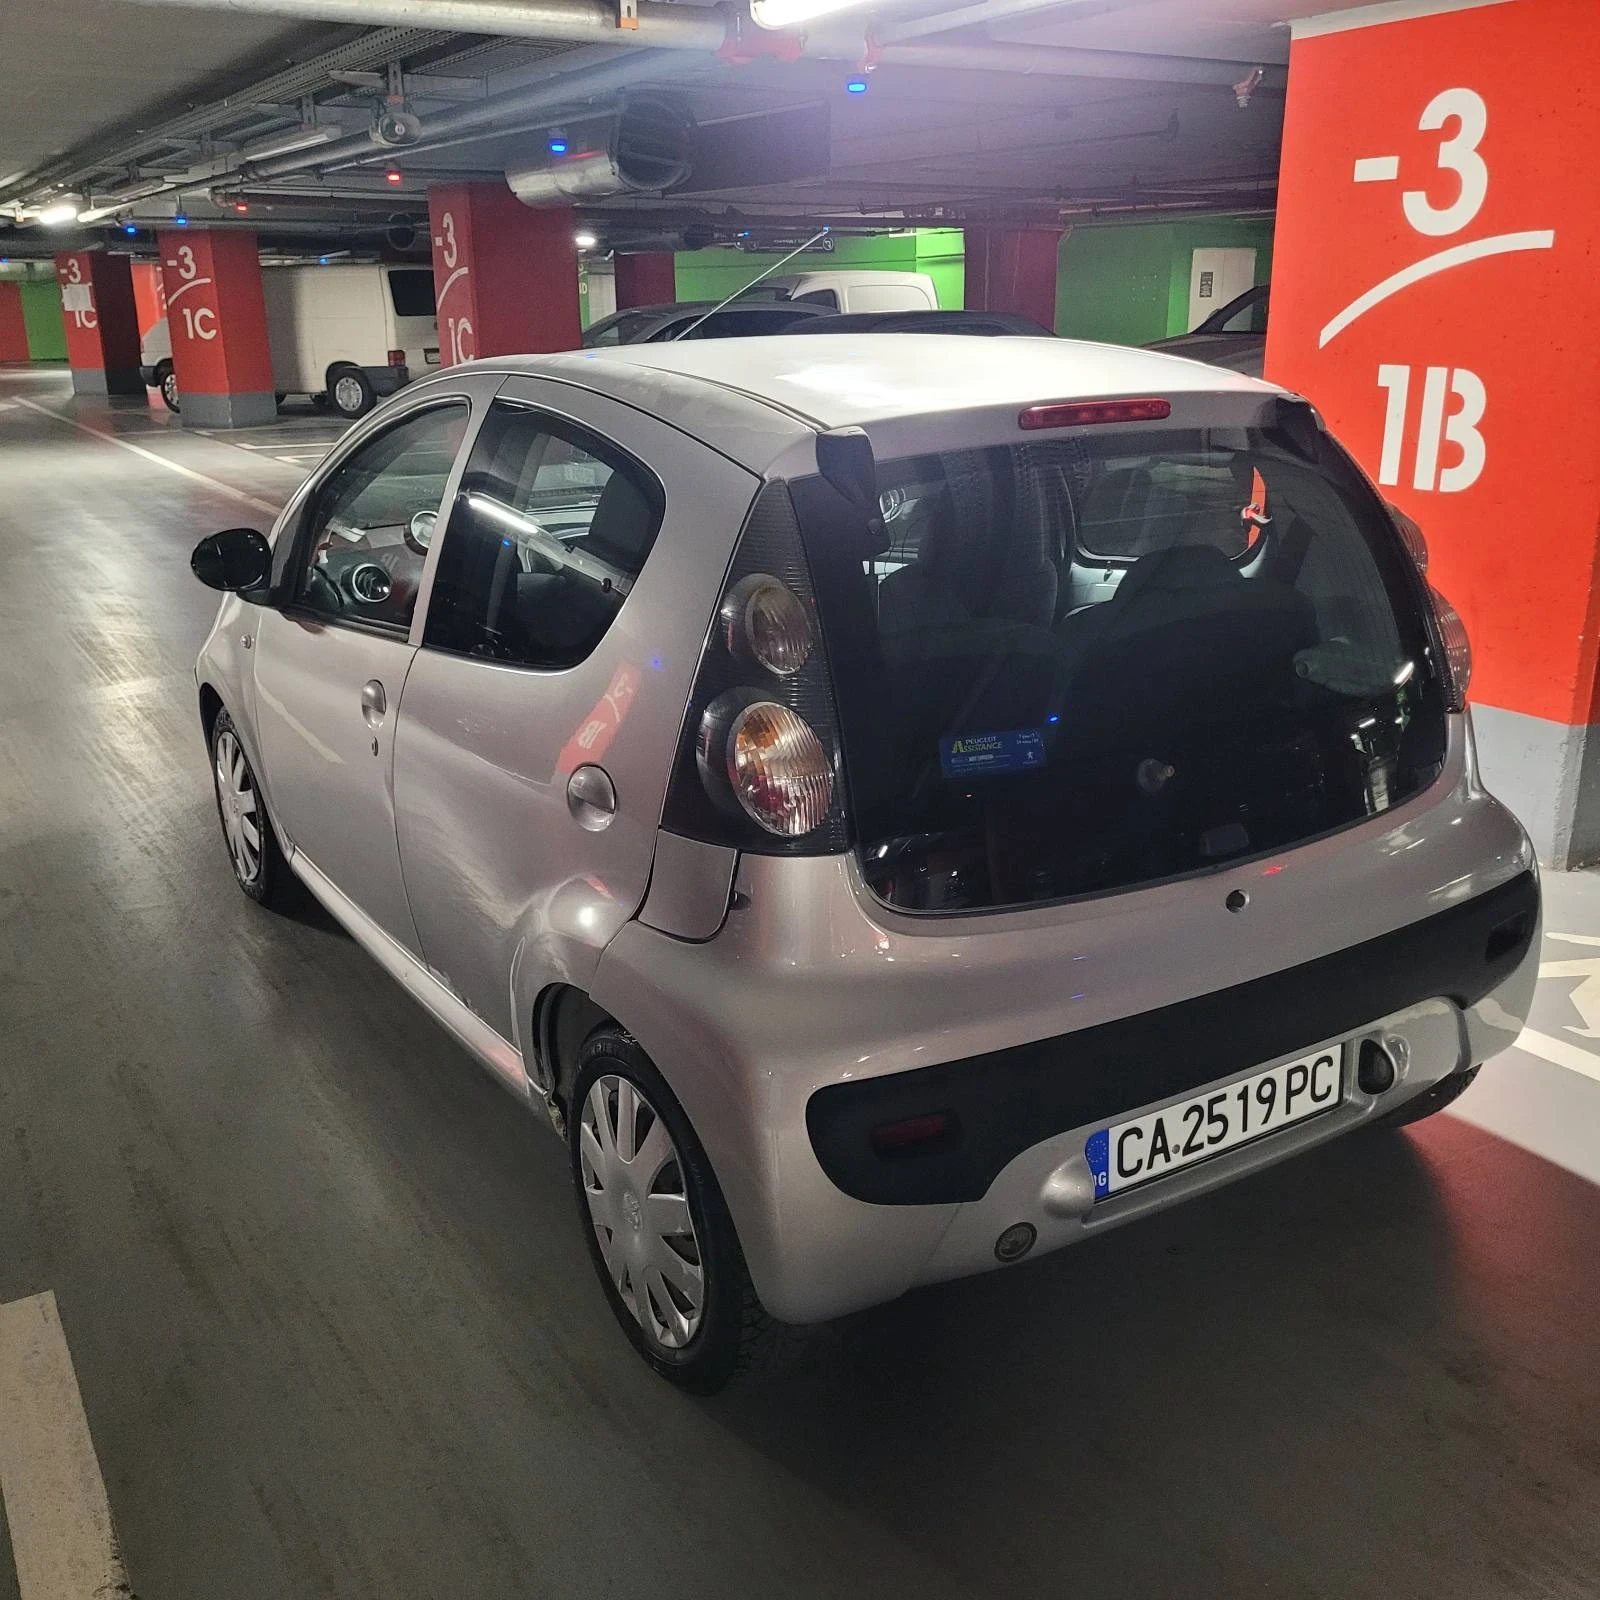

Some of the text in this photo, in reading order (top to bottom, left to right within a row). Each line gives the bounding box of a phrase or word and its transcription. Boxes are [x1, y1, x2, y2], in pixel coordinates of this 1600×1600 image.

[1353, 87, 1489, 237] -3
[167, 246, 197, 280] -3
[435, 212, 458, 268] -3
[60, 258, 82, 284] -3
[182, 307, 218, 340] 1C
[448, 317, 475, 368] 1C
[1377, 364, 1487, 493] 1B
